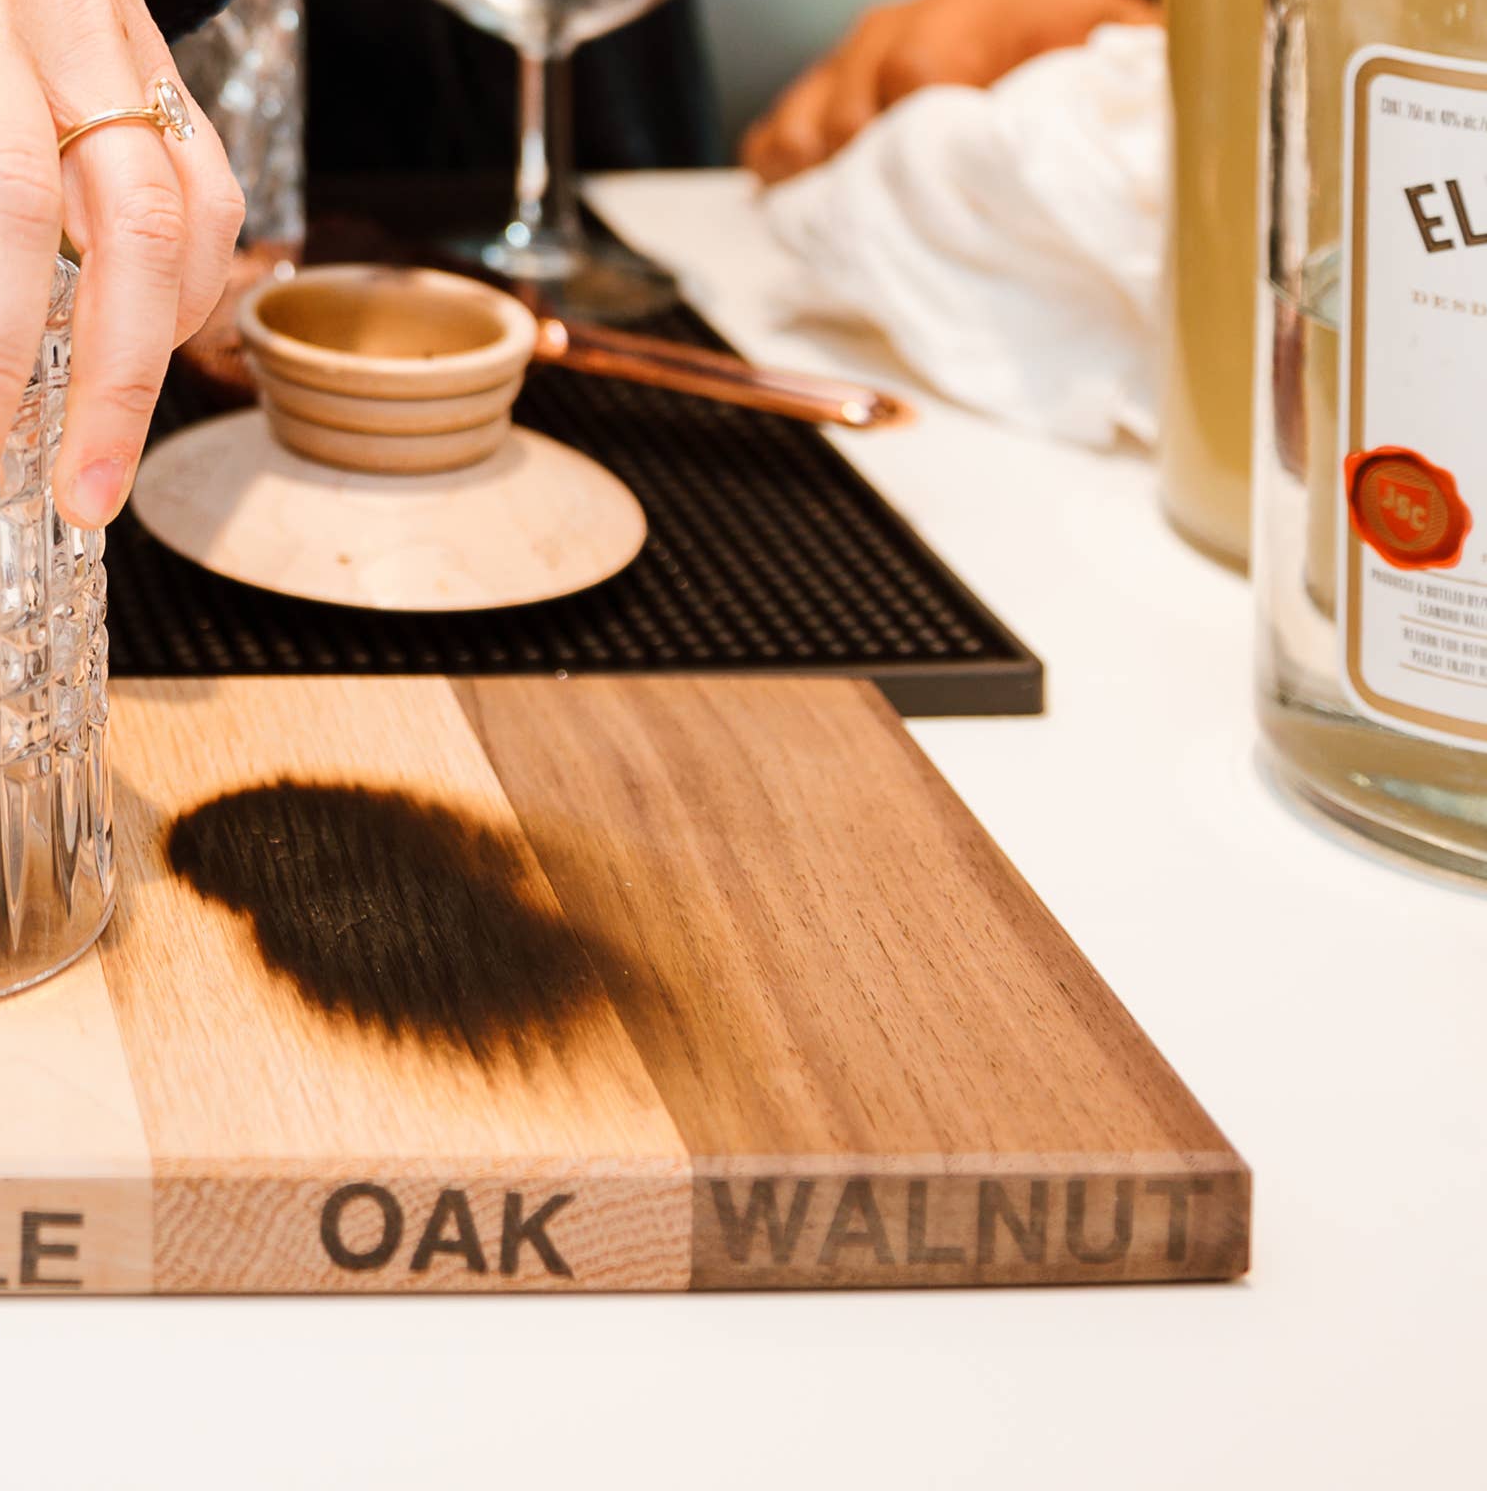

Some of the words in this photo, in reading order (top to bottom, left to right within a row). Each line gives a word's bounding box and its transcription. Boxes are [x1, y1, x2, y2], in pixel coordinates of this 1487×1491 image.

[1404, 179, 1487, 253] EL
[1380, 484, 1426, 532] JSC
[317, 1182, 575, 1281] OAK
[710, 1177, 1212, 1267] WALNUT
